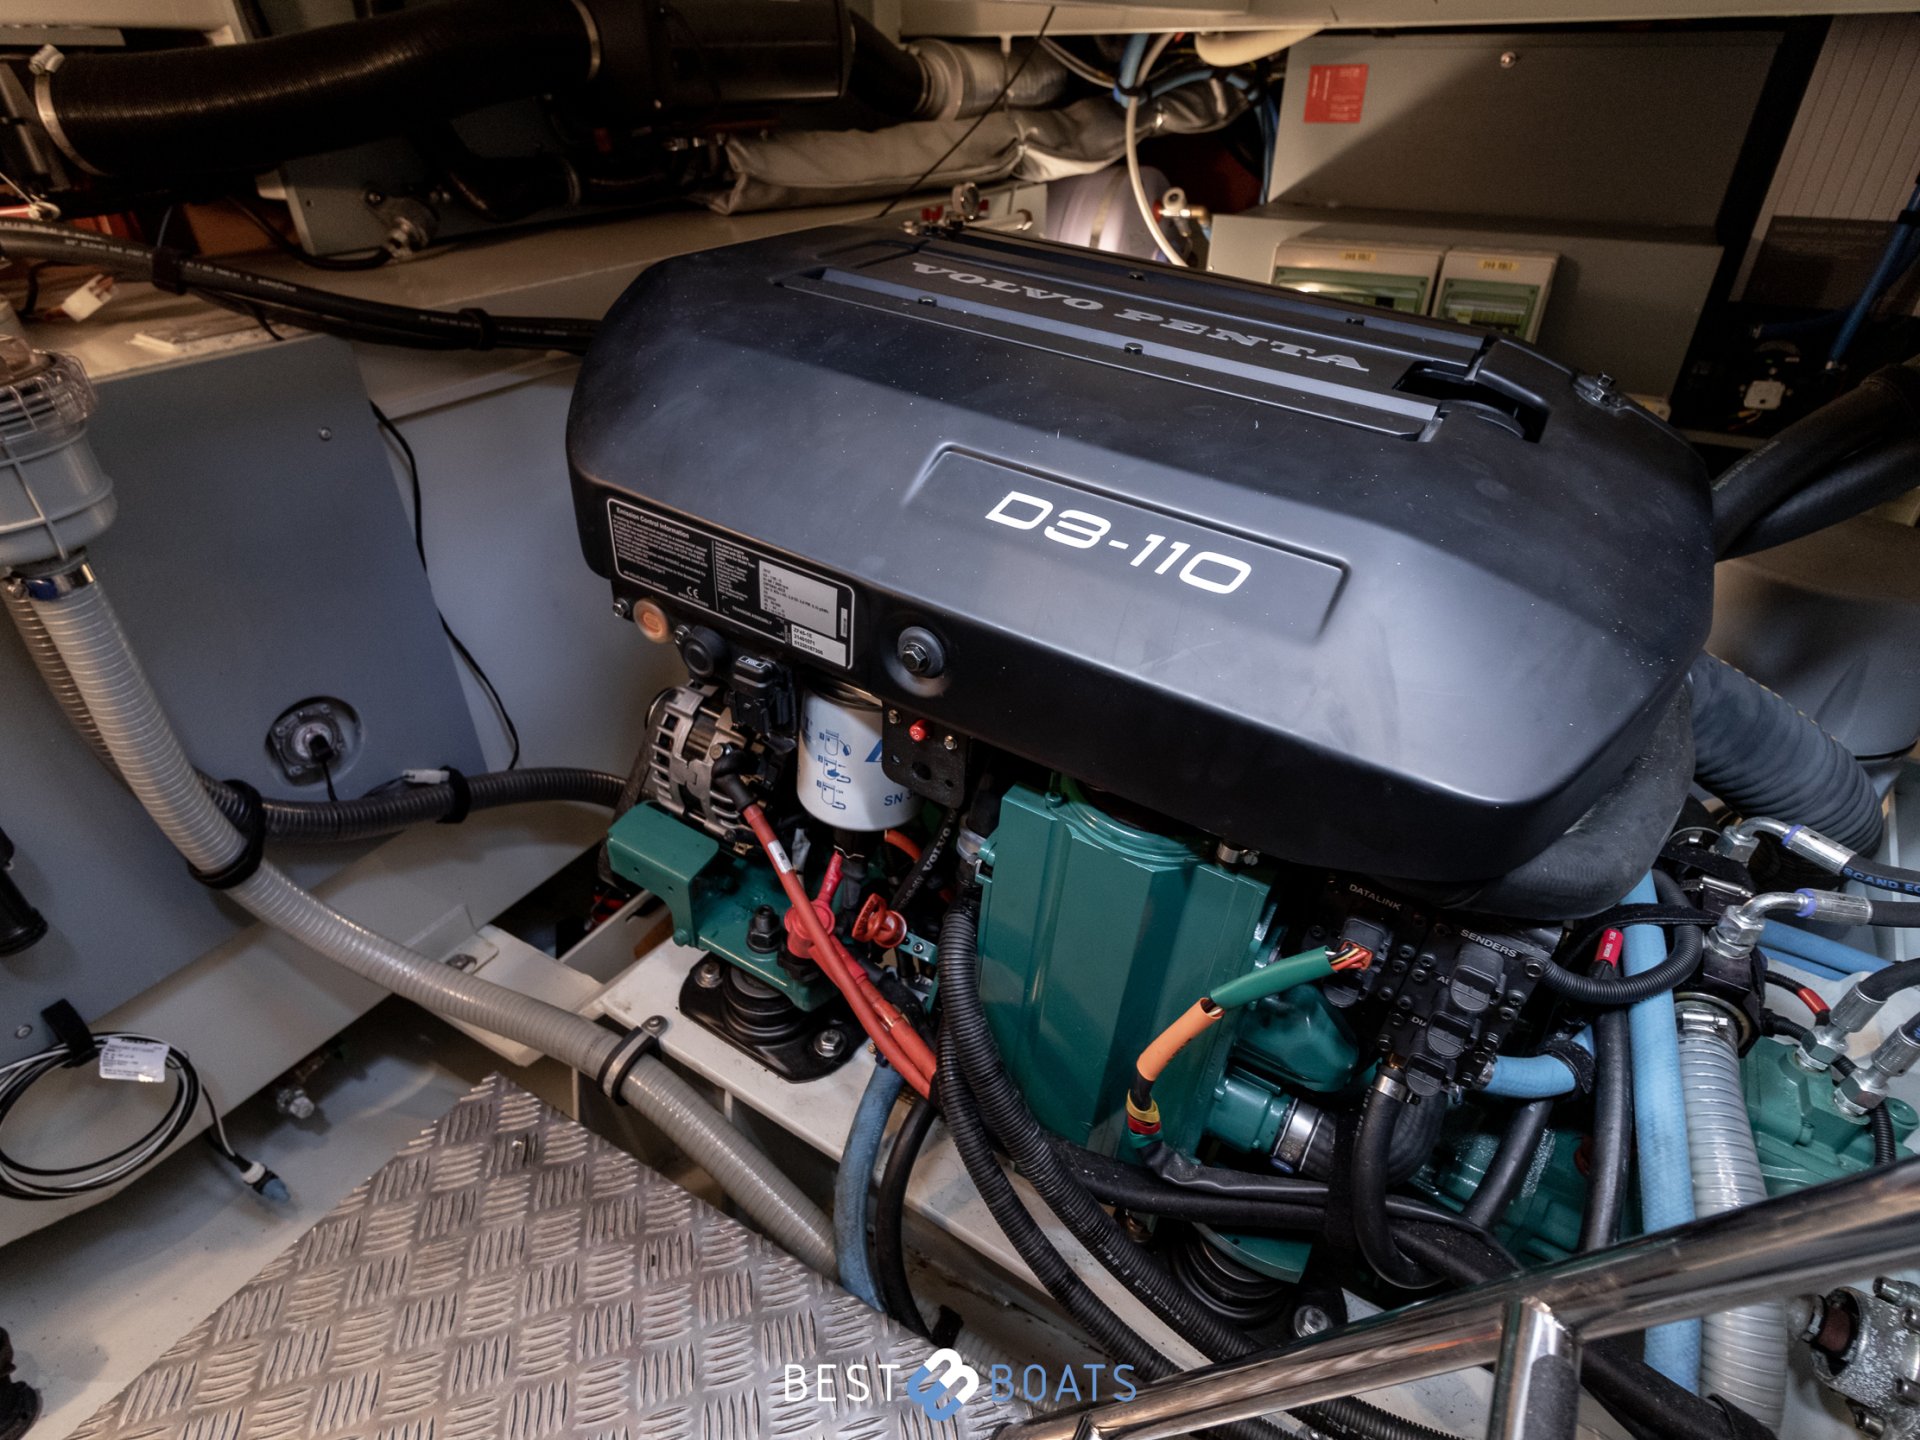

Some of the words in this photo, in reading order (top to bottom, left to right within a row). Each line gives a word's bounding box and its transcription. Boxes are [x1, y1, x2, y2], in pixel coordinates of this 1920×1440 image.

[912, 262, 1105, 312] VOLVO
[1114, 308, 1370, 373] PENTA
[640, 515, 659, 527] Control
[660, 523, 690, 539] Information
[985, 490, 1252, 594] D3-110
[884, 793, 903, 806] SN
[922, 827, 951, 871] VOLVO
[1843, 867, 1899, 889] SCAND
[1349, 883, 1401, 911] DATALINK
[1460, 929, 1517, 958] SENDERS
